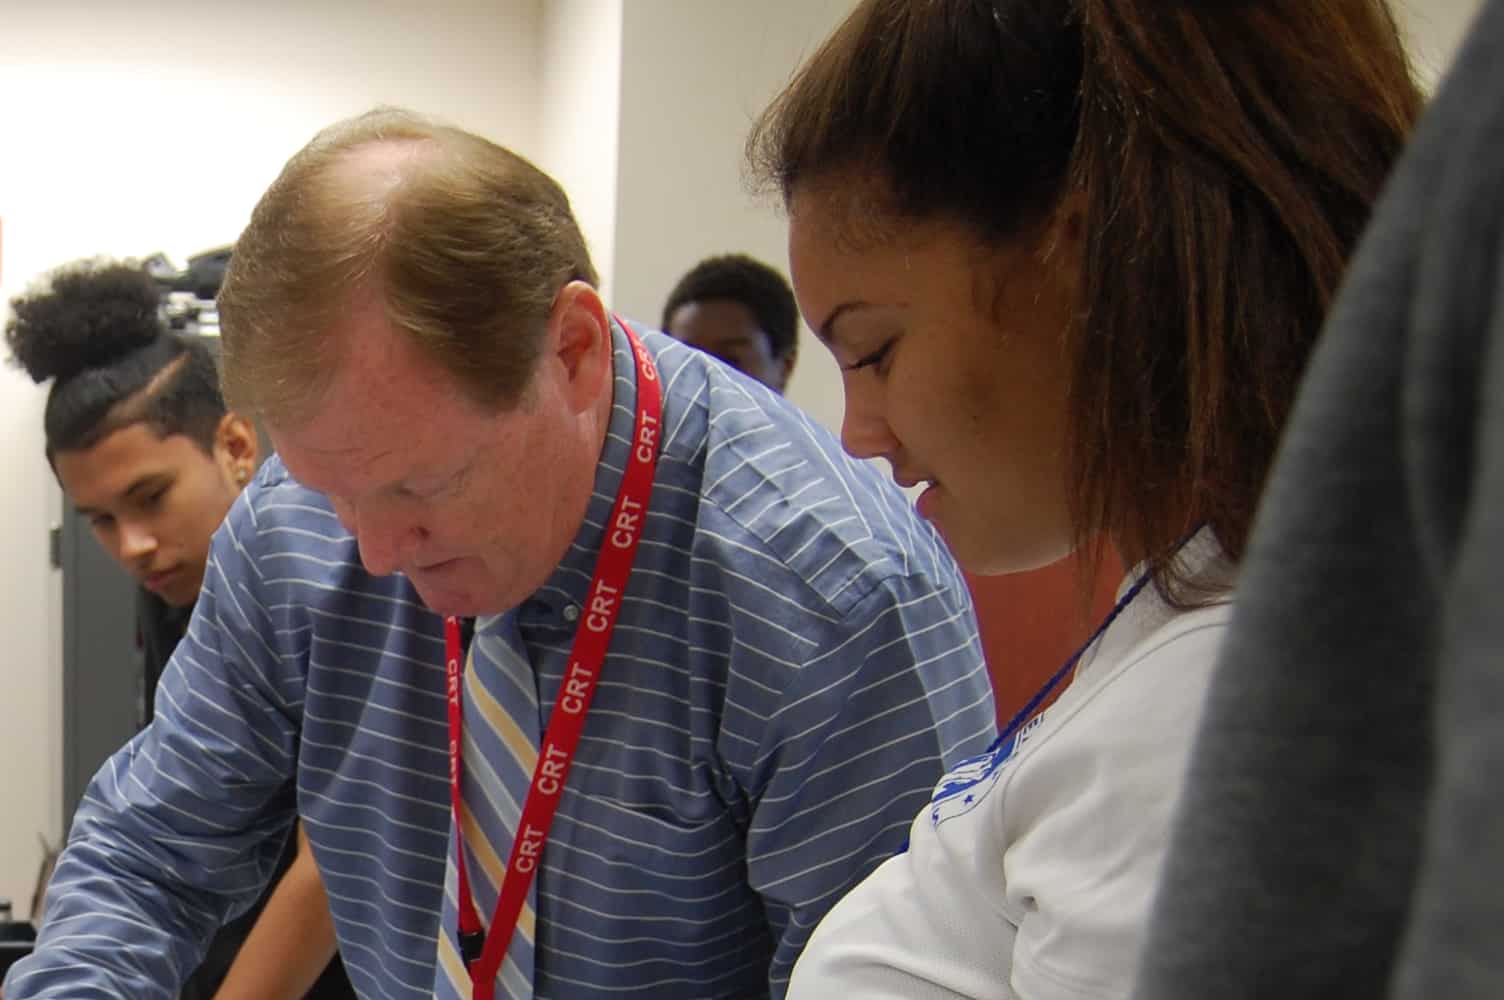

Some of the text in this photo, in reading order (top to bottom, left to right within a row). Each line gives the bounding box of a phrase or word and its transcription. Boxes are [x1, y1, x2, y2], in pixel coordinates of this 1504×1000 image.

[636, 411, 657, 463] CRT
[612, 496, 642, 549] CRT
[586, 580, 618, 633] CRT
[447, 659, 459, 704] CRT
[561, 662, 593, 714] CRT
[538, 743, 568, 796] CRT
[515, 825, 544, 873] CRT
